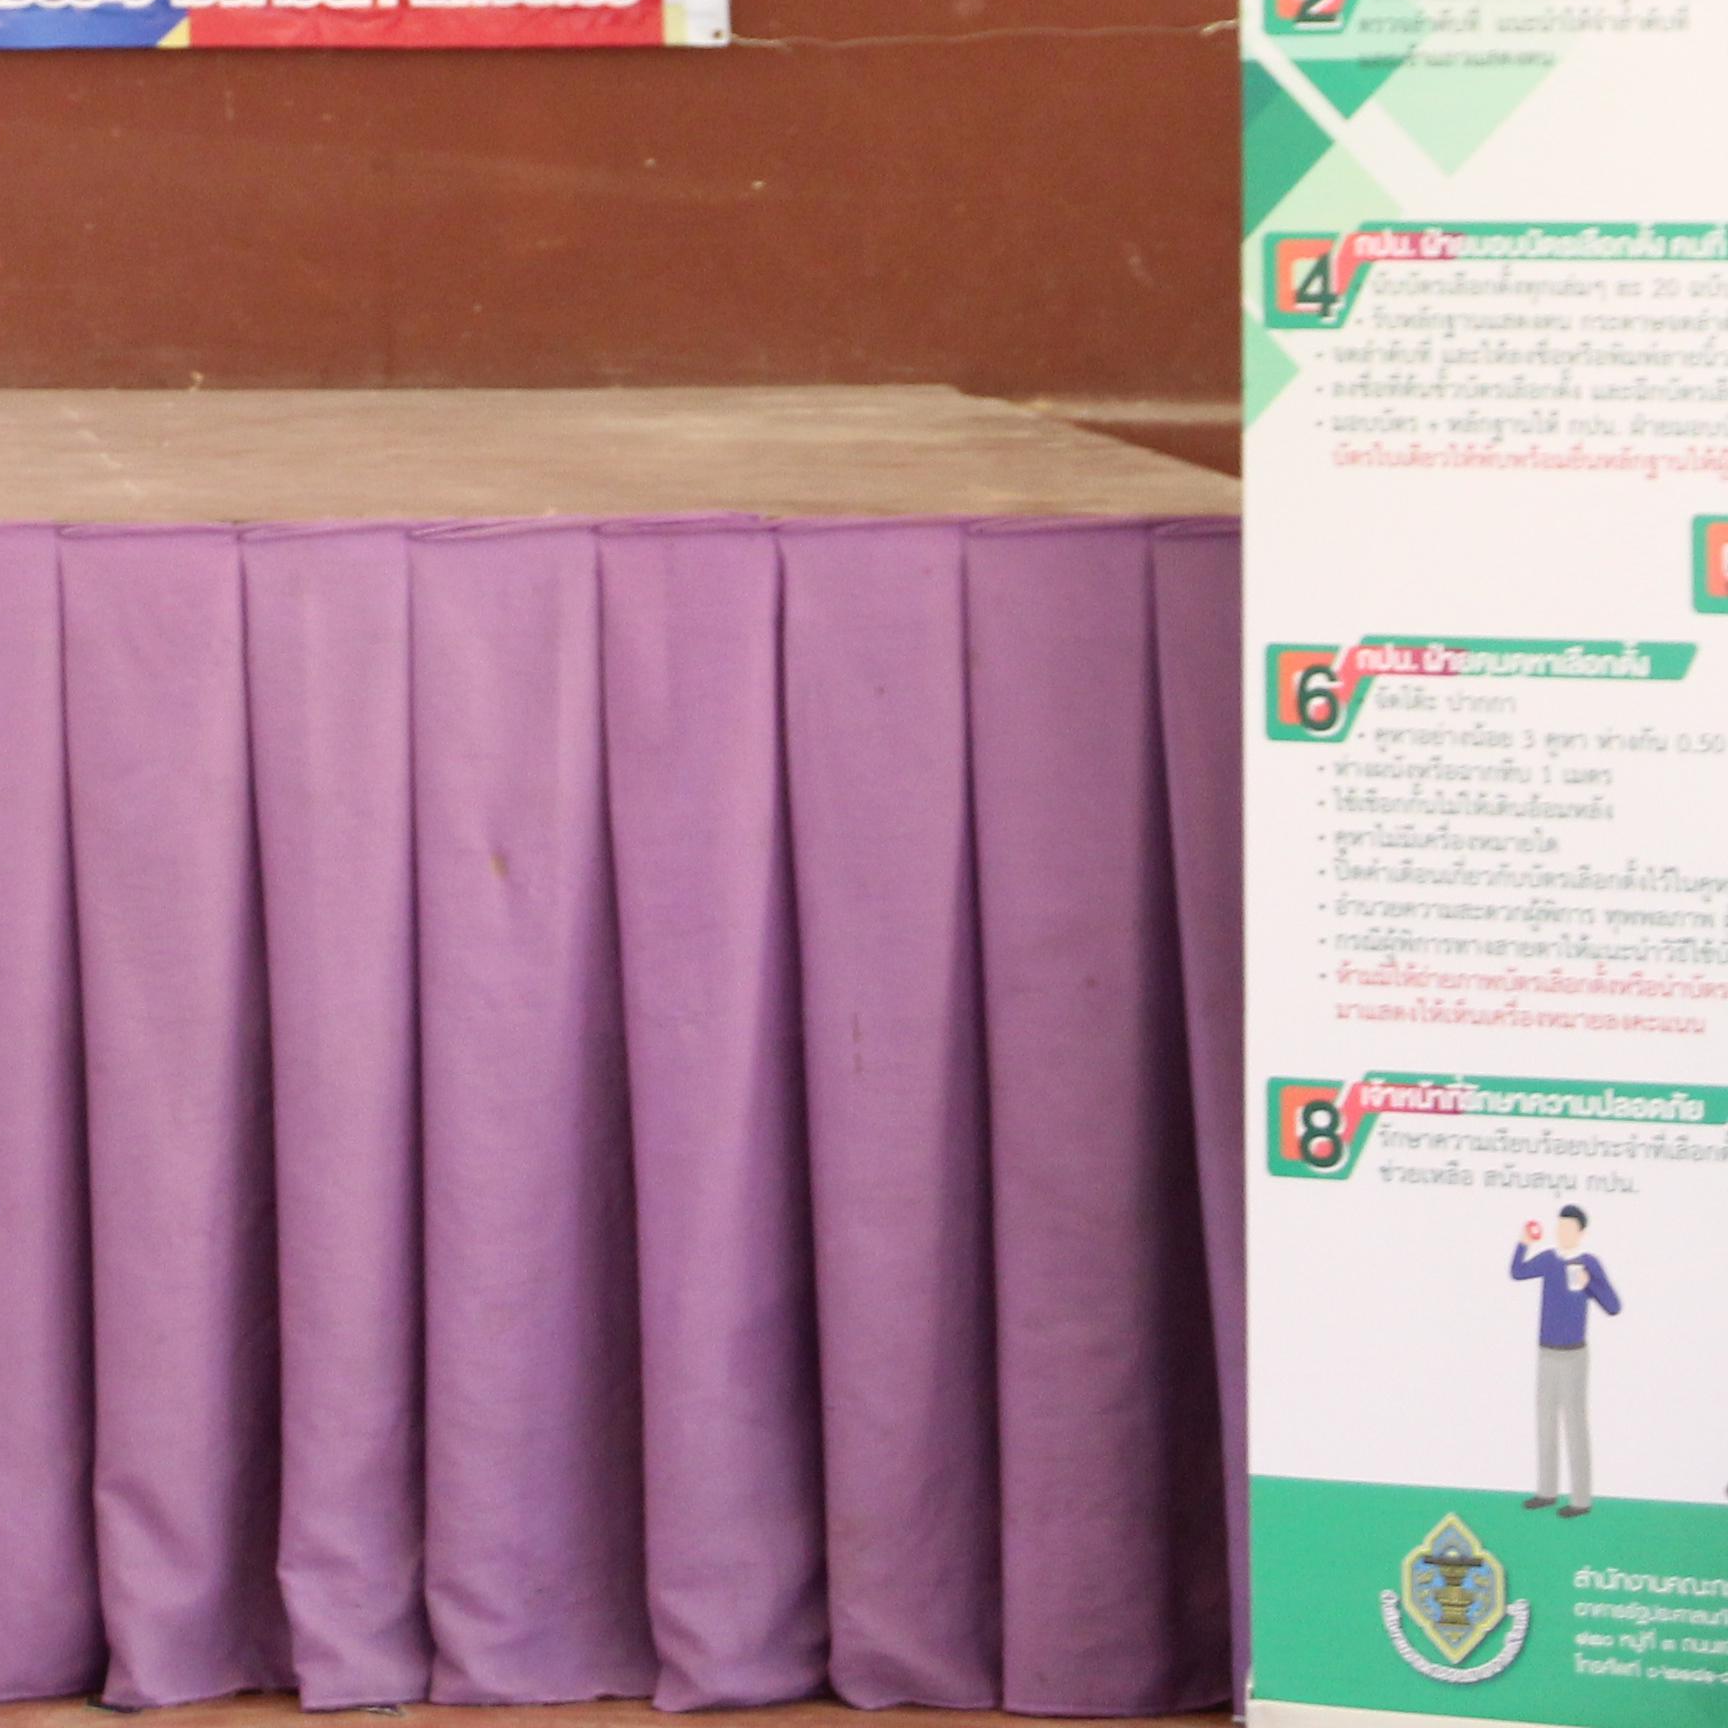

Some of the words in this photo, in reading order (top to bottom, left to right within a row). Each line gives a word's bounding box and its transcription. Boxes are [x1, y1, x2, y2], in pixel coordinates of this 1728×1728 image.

[1294, 255, 1340, 319] 4
[1297, 664, 1342, 731] 6
[1300, 1099, 1343, 1170] 8
